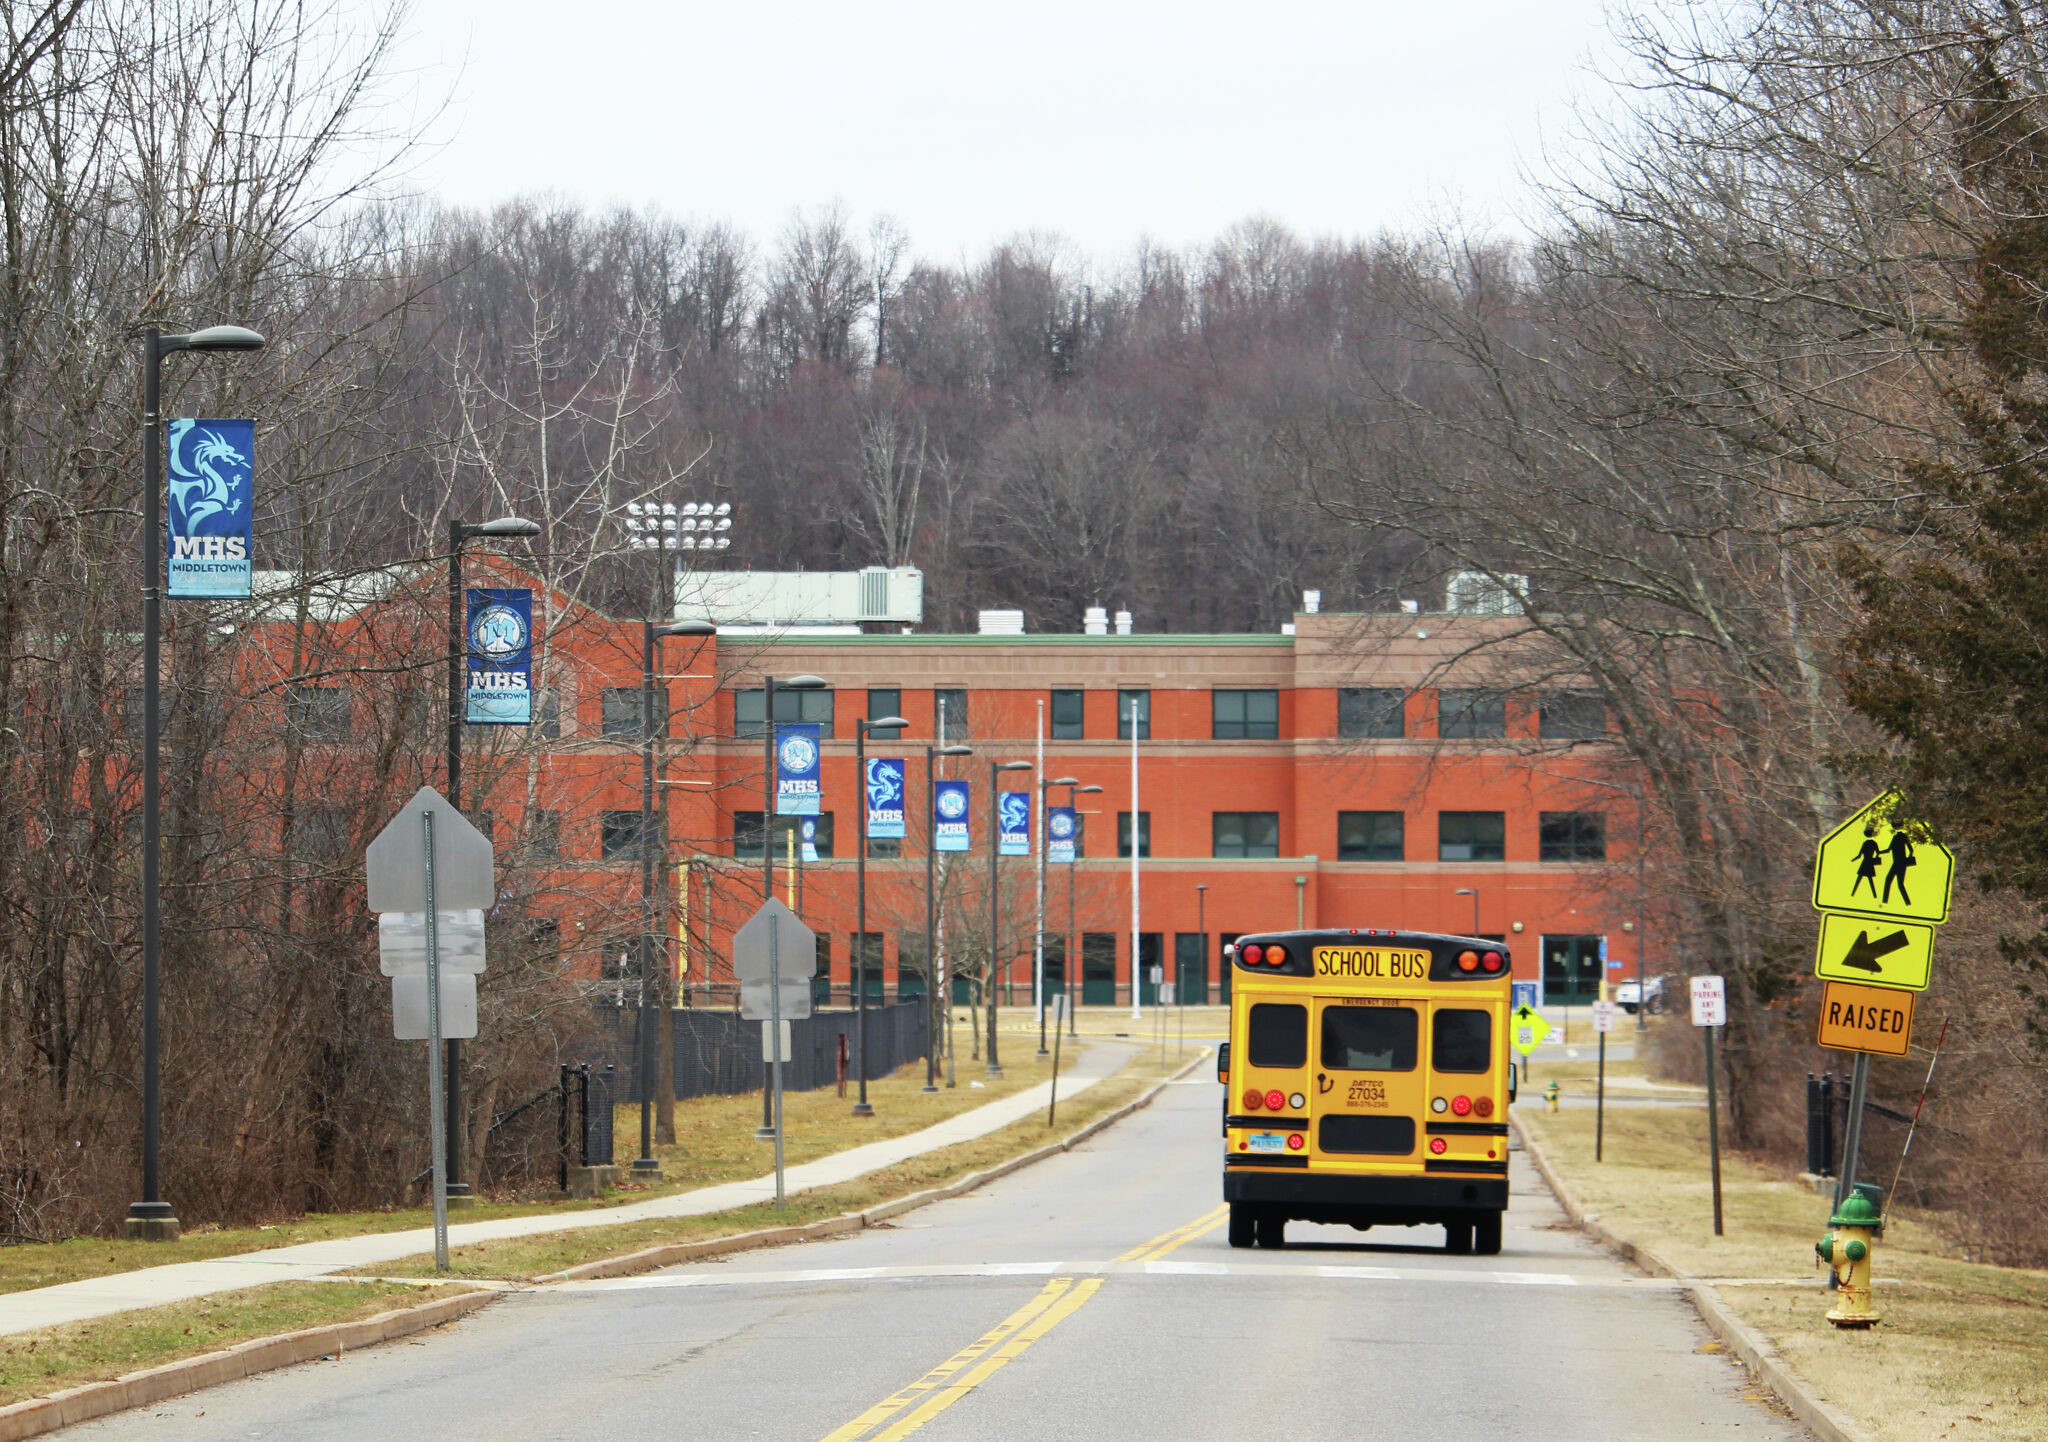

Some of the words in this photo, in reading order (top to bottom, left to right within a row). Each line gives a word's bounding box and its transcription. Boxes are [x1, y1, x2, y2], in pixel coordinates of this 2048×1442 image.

[172, 536, 247, 560] MHS
[172, 563, 247, 572] MIDDLETOWN
[471, 671, 528, 690] MHS
[778, 780, 818, 793] MHS
[869, 809, 903, 821] MHS
[937, 823, 967, 833] MHS
[1001, 833, 1027, 842] MHS
[1319, 950, 1385, 976] SCHOOL
[1390, 953, 1424, 978] BUS
[1702, 981, 1712, 989] NO
[1829, 1002, 1904, 1033] RAISED
[1348, 1087, 1385, 1100] 27034
